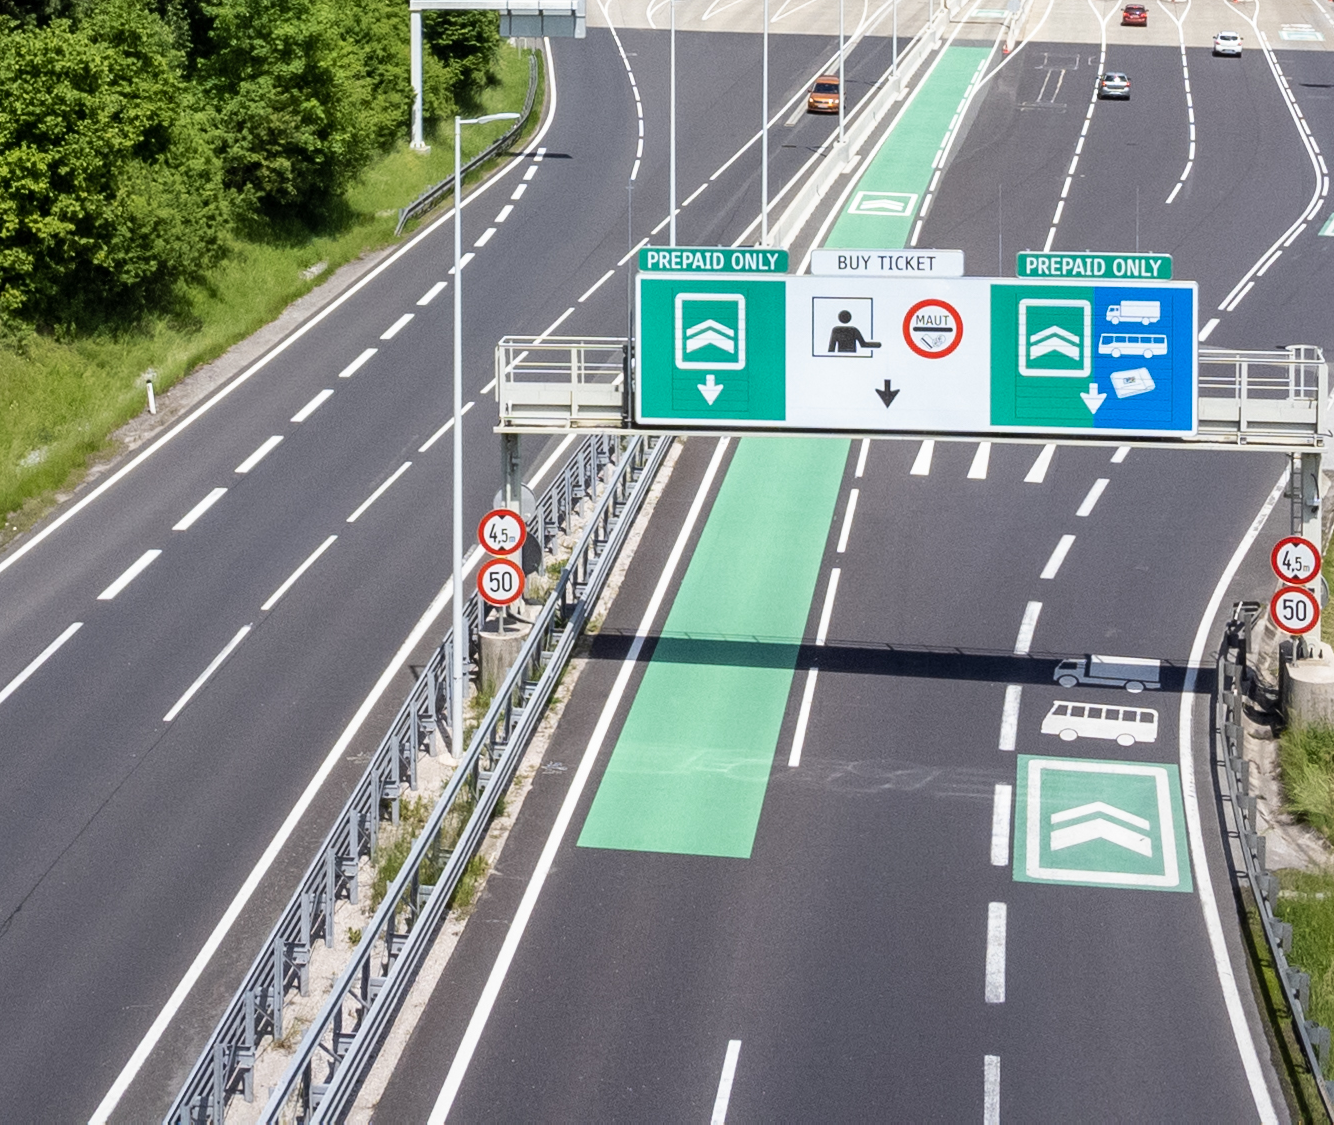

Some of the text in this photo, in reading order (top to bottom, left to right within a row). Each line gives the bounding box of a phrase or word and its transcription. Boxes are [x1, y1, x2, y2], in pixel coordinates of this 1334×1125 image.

[647, 251, 779, 270] PREPAID ONLY
[838, 255, 936, 271] BUY TICKET
[1026, 257, 1162, 277] PREPAID ONLY
[916, 315, 949, 326] MAUT
[489, 571, 512, 593] 50
[1283, 598, 1307, 622] 50
